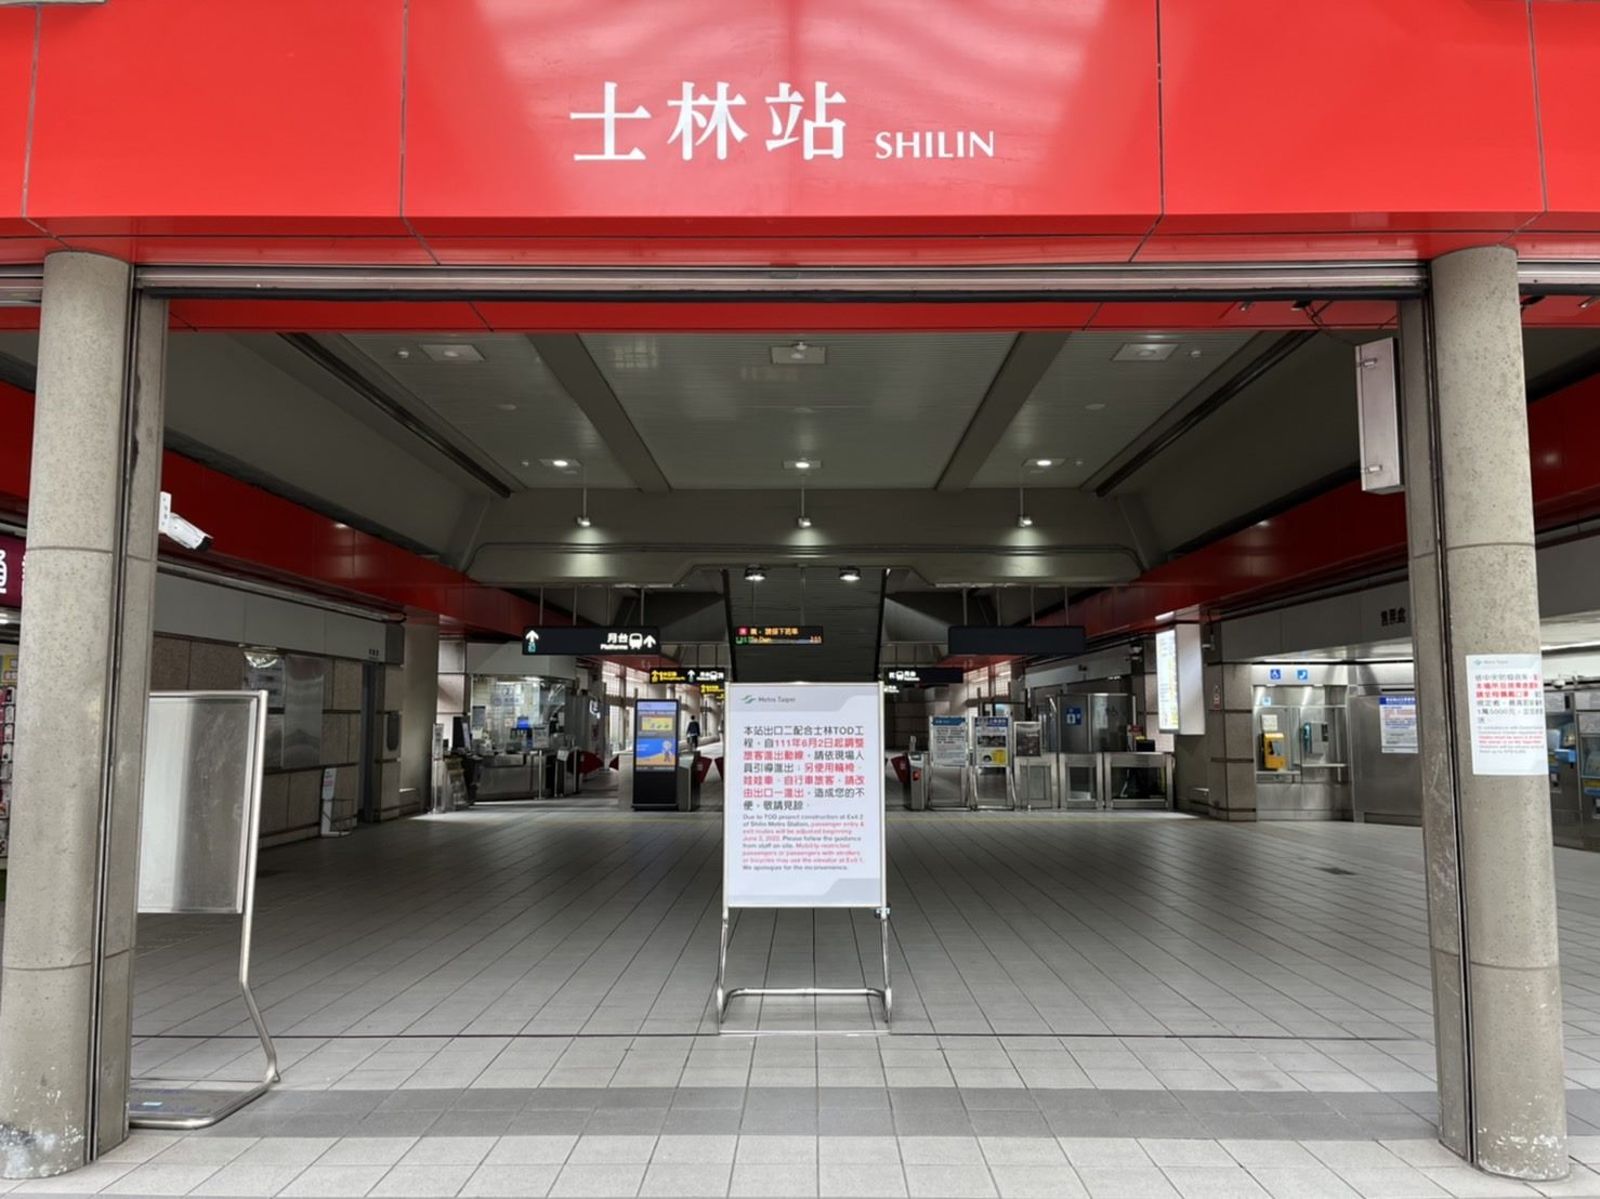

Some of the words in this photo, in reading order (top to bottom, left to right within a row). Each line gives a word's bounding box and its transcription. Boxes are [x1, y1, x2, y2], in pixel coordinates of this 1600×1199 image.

[570, 81, 847, 161] 士林站
[876, 130, 995, 159] SHILIN
[607, 632, 628, 643] 月台
[743, 725, 864, 736] 本站出口二配合士林TOD工
